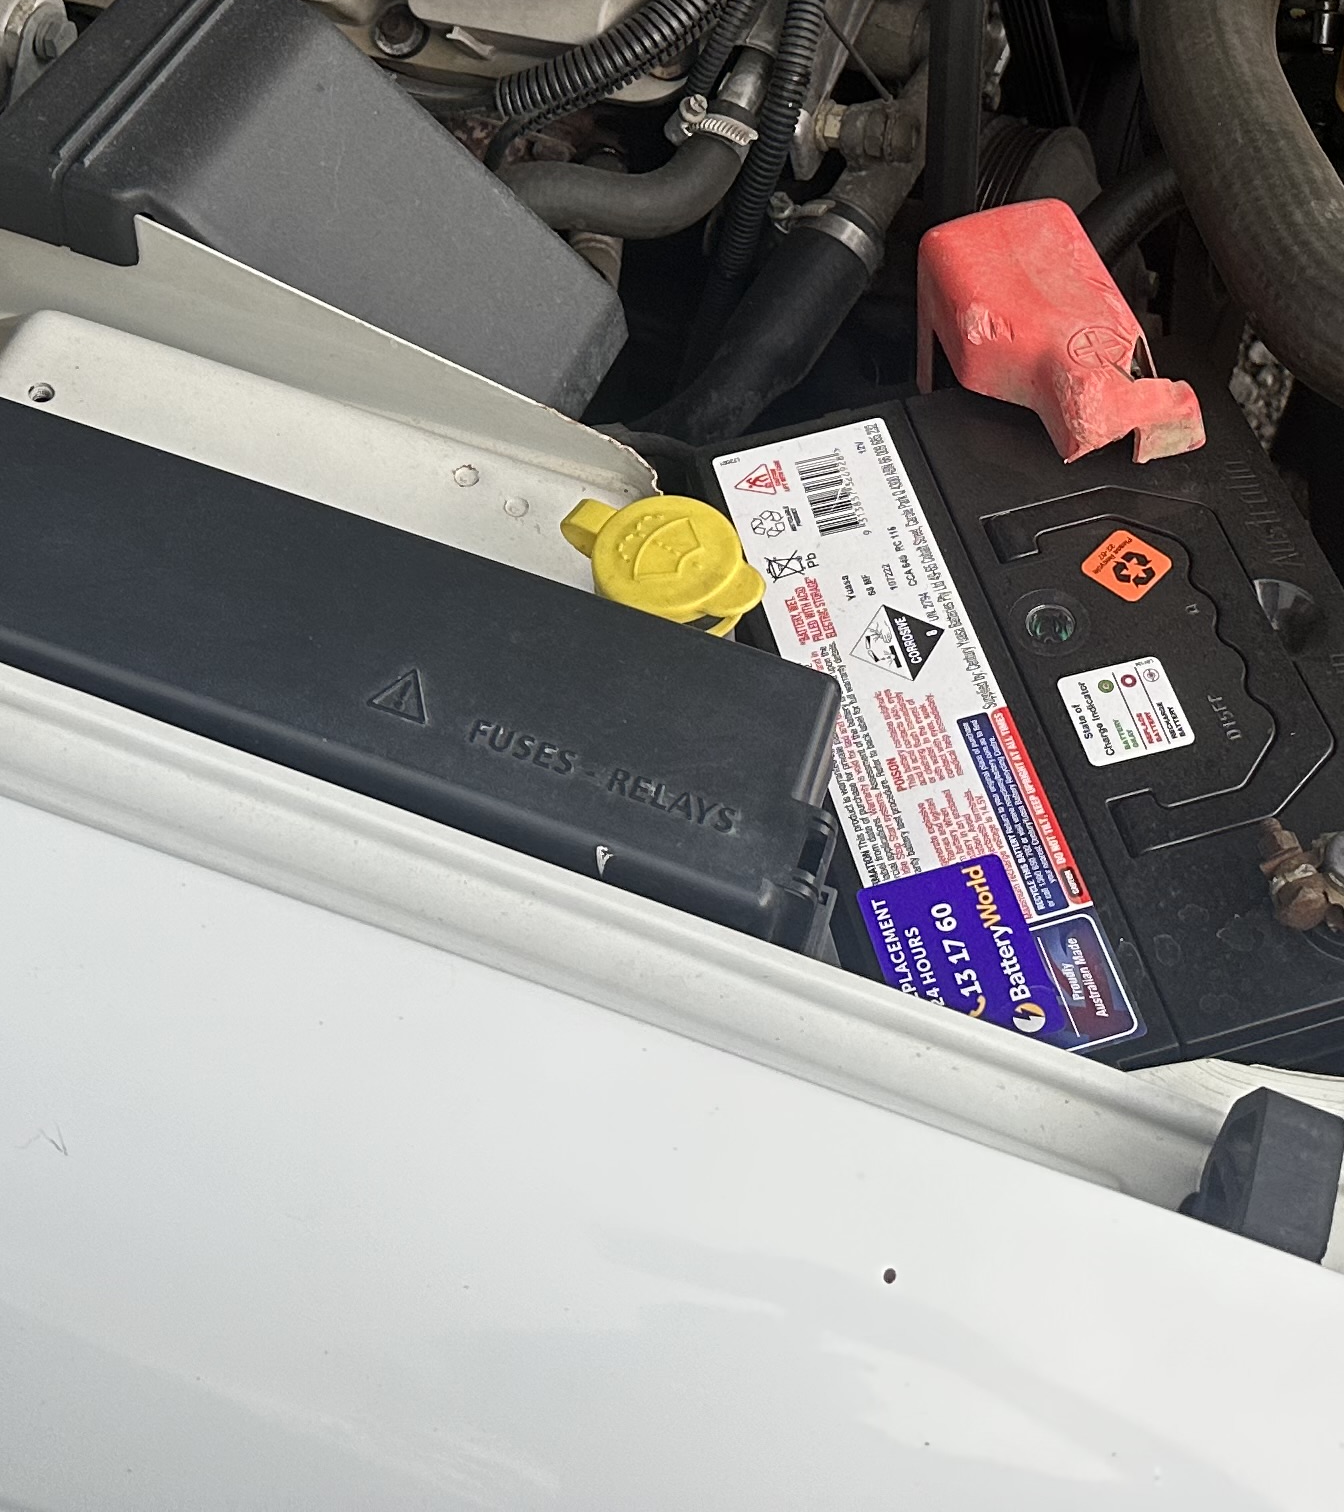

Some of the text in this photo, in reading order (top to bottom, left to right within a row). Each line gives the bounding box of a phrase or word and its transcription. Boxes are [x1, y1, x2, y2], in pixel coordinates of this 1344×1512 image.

[854, 440, 866, 454] 12V
[895, 494, 910, 510] Park
[1221, 460, 1303, 570] Australia
[805, 552, 819, 568] Pb
[892, 539, 904, 552] RC
[841, 574, 856, 601] Yuasa
[881, 563, 898, 590] 107222
[903, 567, 918, 587] CCA
[942, 601, 962, 628] Batteries
[894, 616, 922, 663] CORROSIVE
[925, 628, 938, 636] 8
[953, 626, 969, 648] Yuasa
[1070, 703, 1093, 739] State of
[1077, 681, 1115, 756] Charge Indicator
[1143, 711, 1162, 742] BATTERY
[1166, 706, 1186, 737] BATTERY
[1112, 719, 1131, 750] BATTERY
[469, 719, 577, 776] FUSES
[607, 766, 743, 836] RELAYS
[886, 757, 906, 792] POISON
[993, 712, 1066, 865] DO NOT TILT, KEEP UPRIGHT AT ALL TIMES
[1007, 834, 1026, 863] BATTERY
[1019, 863, 1032, 880] THIS
[1026, 879, 1045, 910] RECYCLE
[963, 865, 1029, 1000] BatteryWorld
[871, 900, 918, 1001] PLACEMENT
[930, 902, 982, 996] 13 17 60
[904, 927, 944, 1008] 24 HOURS
[1061, 962, 1084, 1000] Proudly
[1067, 937, 1108, 1016] Australian Made
